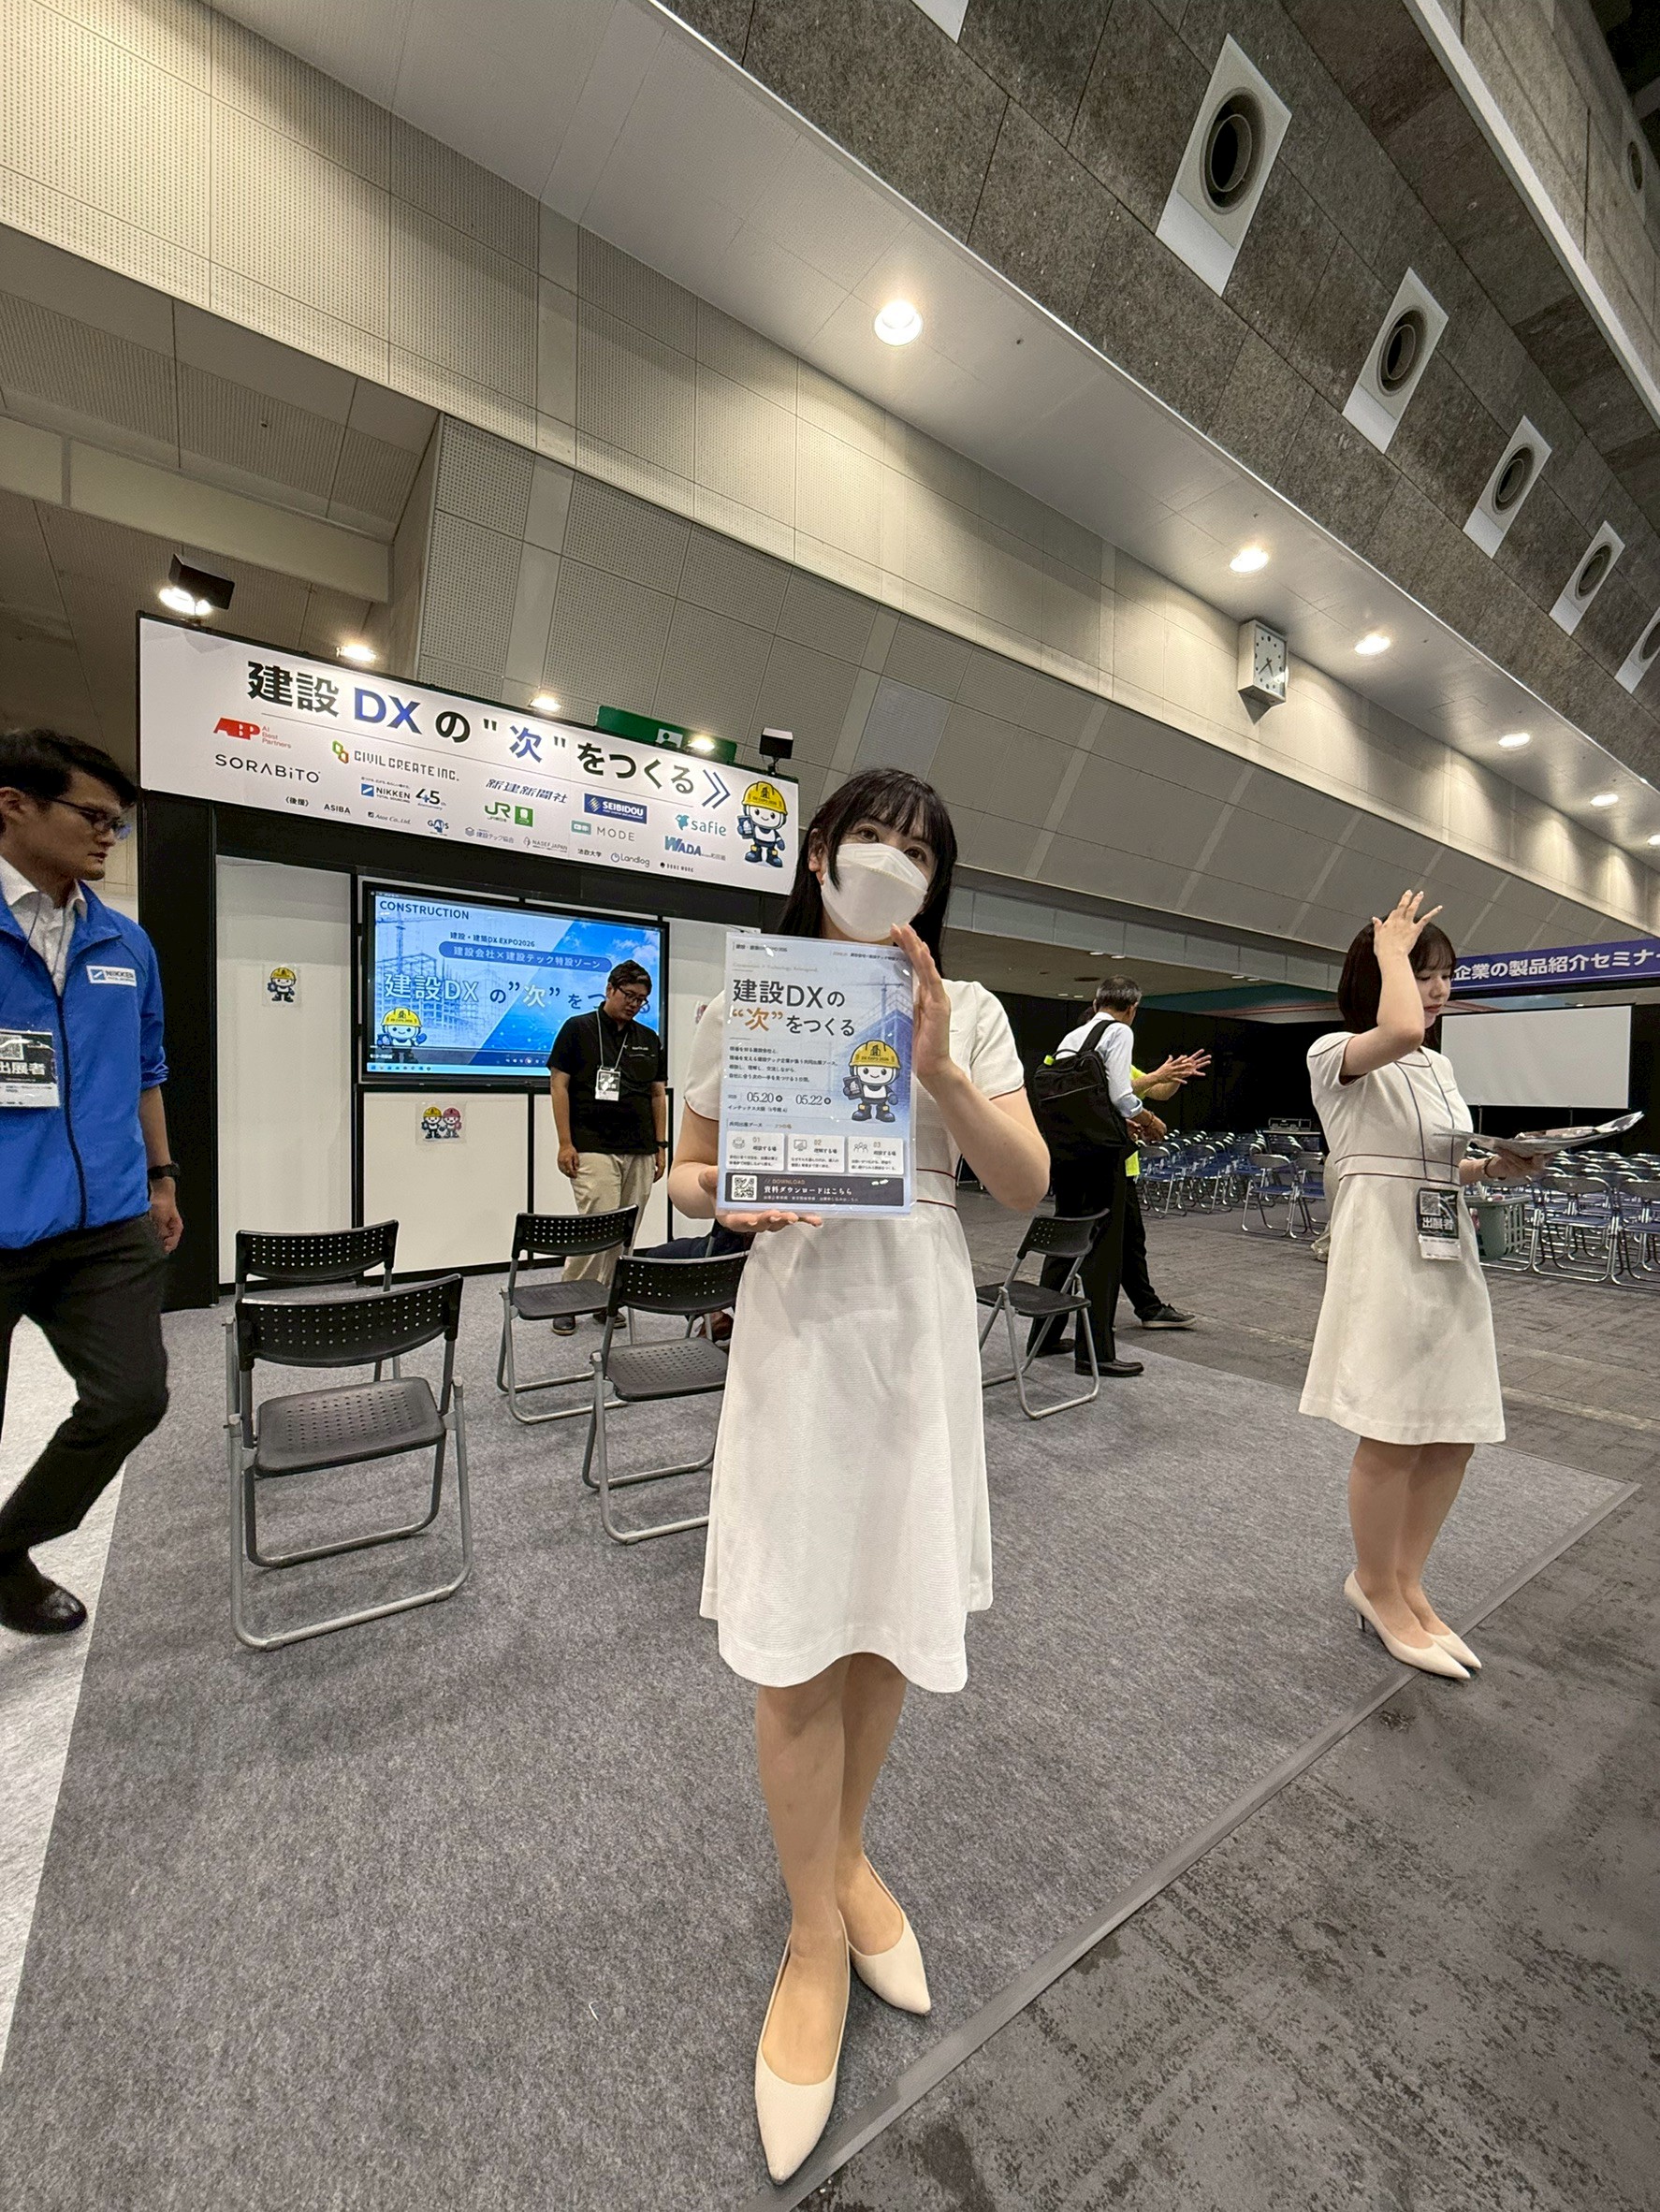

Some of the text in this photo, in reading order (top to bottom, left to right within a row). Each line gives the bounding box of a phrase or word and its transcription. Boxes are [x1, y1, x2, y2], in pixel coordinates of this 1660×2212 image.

[247, 661, 339, 717] 建設
[354, 687, 422, 735] DX
[435, 710, 471, 743] の
[577, 743, 694, 795] をつくる
[262, 738, 292, 749] Partners
[355, 750, 386, 767] CIVIL
[388, 757, 435, 777] CREATE
[376, 787, 411, 799] NIKKEN
[486, 778, 568, 804] 新建新聞社
[324, 804, 351, 814] ASIBA
[485, 802, 511, 819] JR
[602, 801, 644, 816] SEIBIDOU
[597, 826, 635, 841] MODE
[692, 820, 727, 837] safie
[476, 831, 514, 844] 建設テック協会
[664, 836, 701, 856] WADA
[380, 900, 469, 920] CONSTRUCTION
[454, 946, 601, 968] 建設会社×建設テック特設ゾーン
[384, 973, 478, 1002] 建設DX
[733, 979, 845, 1009] 建設DXの
[747, 1092, 774, 1103] 05.20
[795, 1095, 823, 1105] 05.22
[764, 1186, 852, 1196] 資料ダウンロードはこちら
